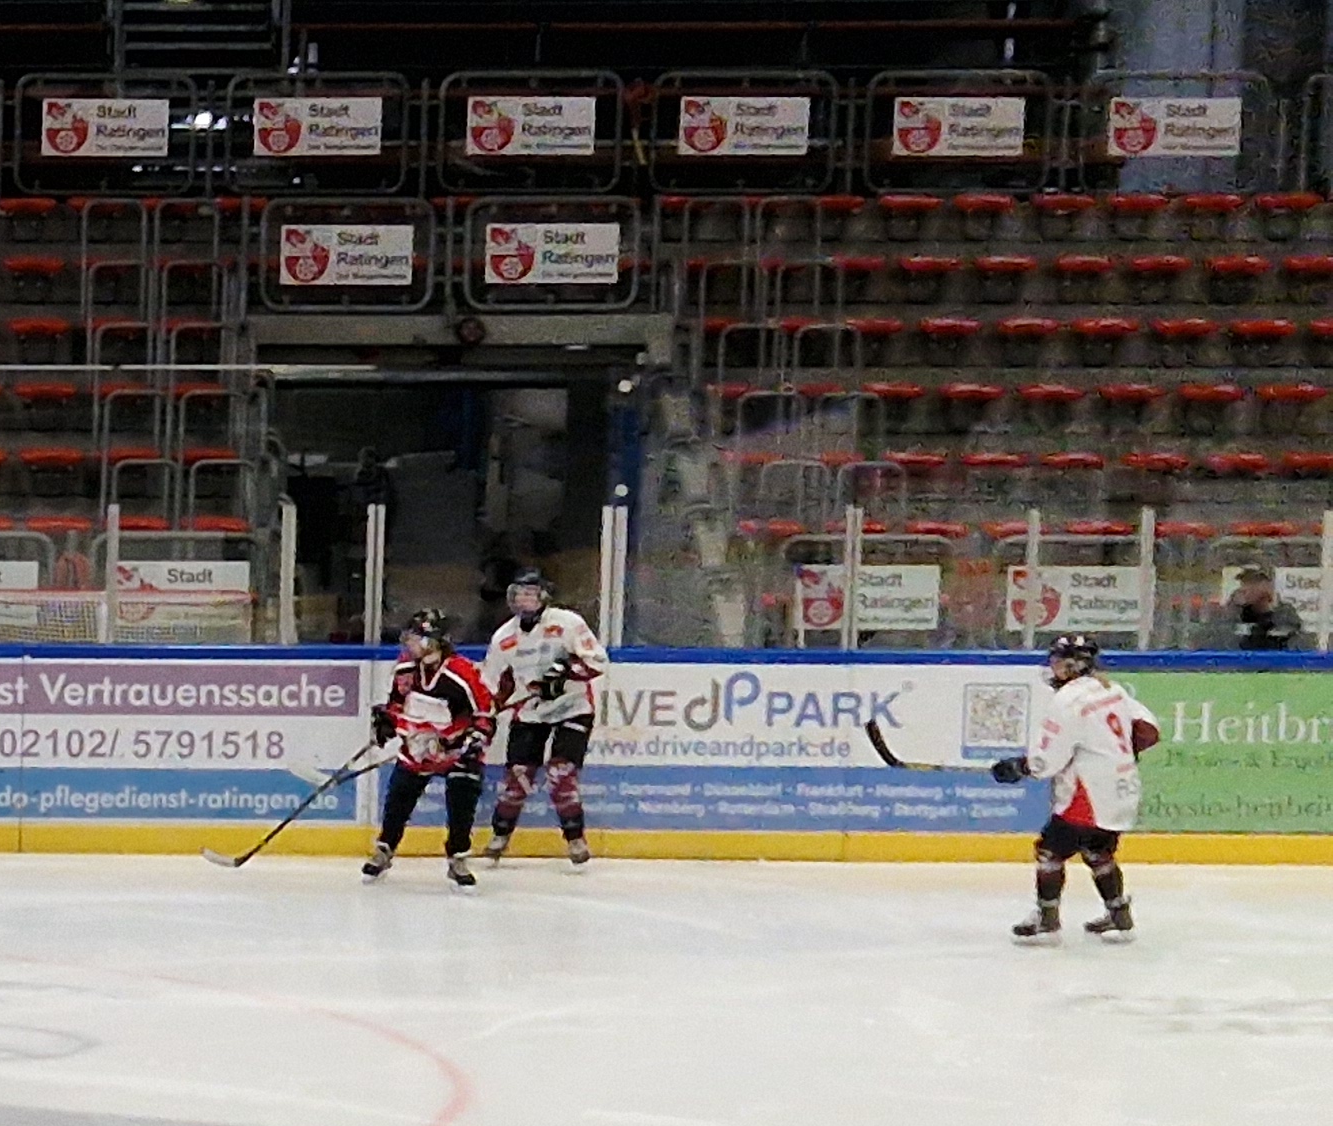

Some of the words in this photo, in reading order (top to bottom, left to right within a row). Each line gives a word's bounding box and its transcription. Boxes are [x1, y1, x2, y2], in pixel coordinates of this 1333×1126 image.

[95, 104, 137, 119] Stadt
[308, 104, 350, 118] Stadt
[522, 103, 563, 117] Stadt
[735, 103, 778, 117] Stadt
[949, 103, 992, 117] Stadt
[1165, 103, 1208, 117] Stadt
[95, 125, 165, 141] Ratingen
[307, 123, 379, 140] Ratingen
[521, 124, 592, 140] Ratingen
[948, 124, 1021, 139] Ratingen
[1163, 123, 1236, 139] Ratingen
[336, 231, 379, 245] Stadt
[543, 230, 586, 244] Stadt
[335, 252, 410, 268] Ratingen
[541, 250, 617, 267] Ratingen
[167, 568, 214, 584] Stadt
[857, 573, 903, 587] Stadt
[1070, 573, 1118, 587] Stadt
[1069, 595, 1140, 612] Ratinge
[38, 672, 346, 708] Vertrauenssache
[600, 689, 678, 728] IVE
[765, 690, 904, 729] PARK
[132, 729, 286, 760] 5791518
